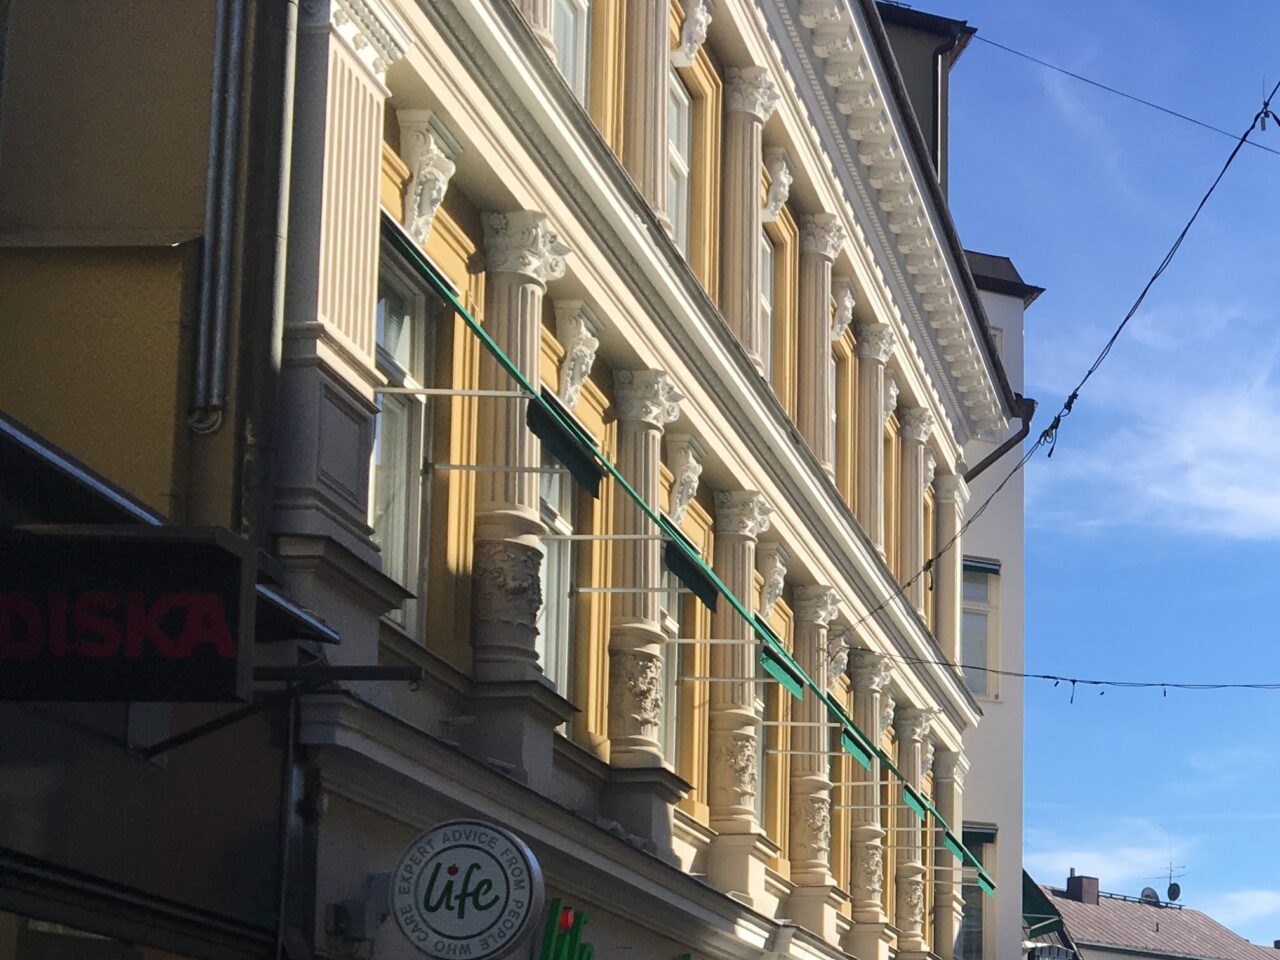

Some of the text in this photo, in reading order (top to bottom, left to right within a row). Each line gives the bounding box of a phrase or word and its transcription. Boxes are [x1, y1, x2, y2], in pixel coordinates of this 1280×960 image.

[399, 829, 526, 956] EXPERT ADVICE FROM PEOPLE WHO CARE
